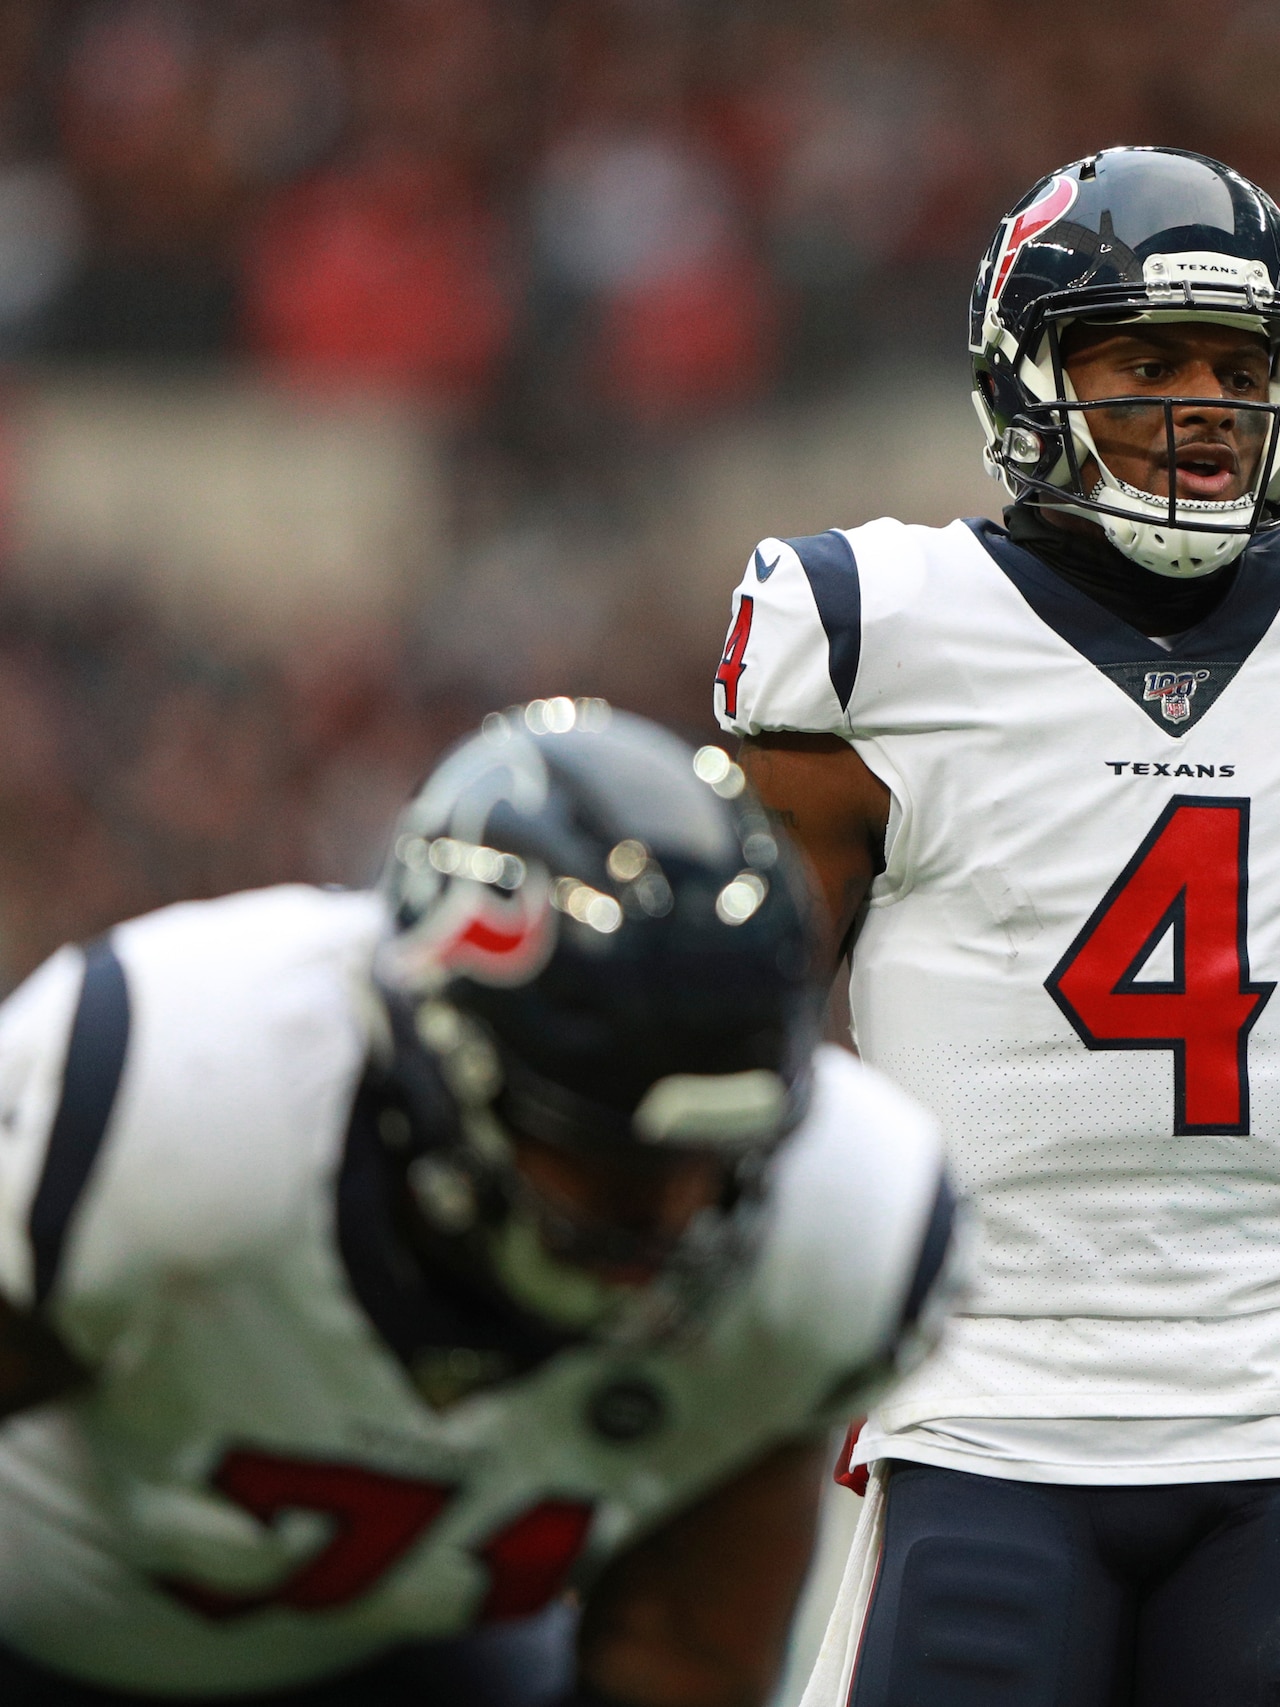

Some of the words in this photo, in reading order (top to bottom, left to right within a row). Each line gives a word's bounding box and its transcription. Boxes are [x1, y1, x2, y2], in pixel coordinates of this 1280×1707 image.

[1176, 263, 1238, 275] TEXANS
[715, 594, 753, 720] 4
[1104, 761, 1236, 779] TEXANS
[1043, 794, 1278, 1137] 4
